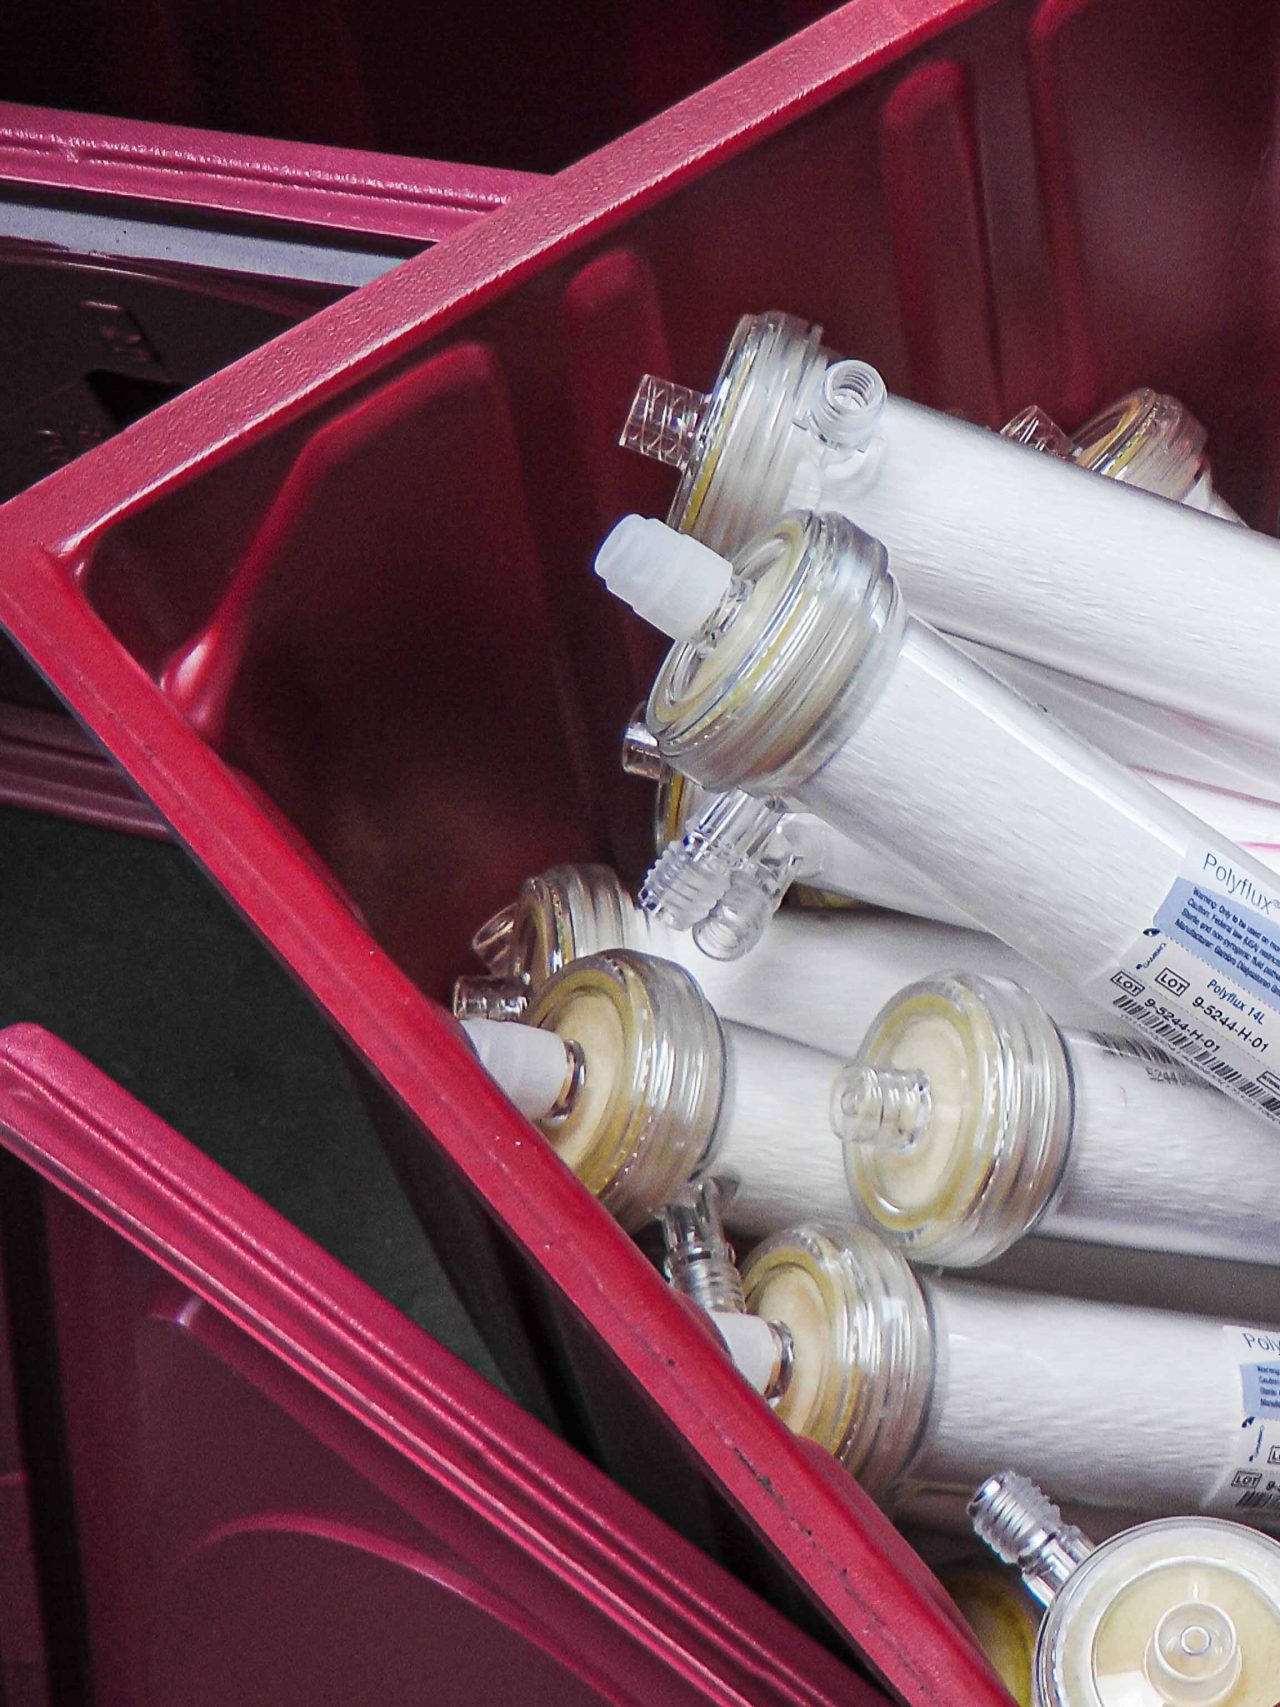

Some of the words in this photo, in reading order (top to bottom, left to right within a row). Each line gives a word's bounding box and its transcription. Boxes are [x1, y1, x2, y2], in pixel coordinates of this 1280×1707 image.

[1145, 999, 1220, 1053] 9-5244-H-01
[1161, 973, 1186, 995] LOT
[1193, 997, 1269, 1052] 9-5244-H-01
[1207, 979, 1246, 1012] Polyflux
[1248, 1007, 1265, 1025] 14L
